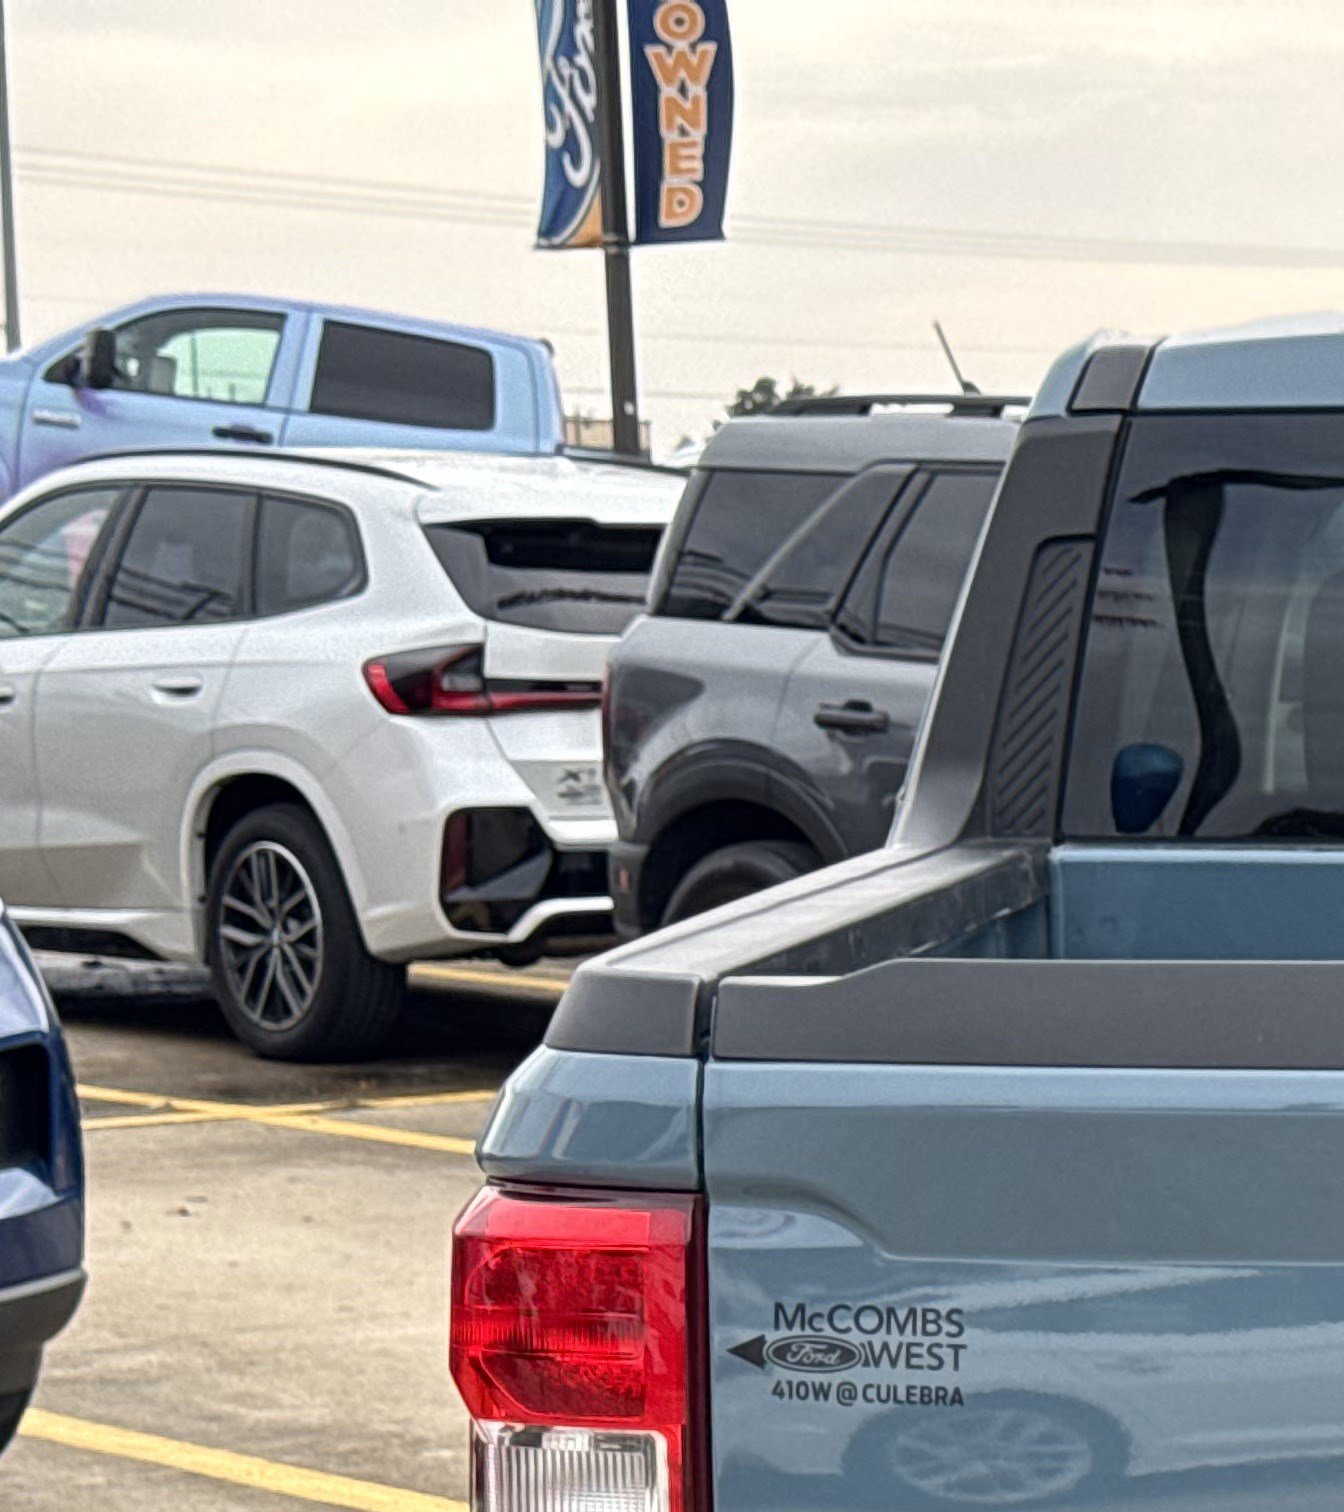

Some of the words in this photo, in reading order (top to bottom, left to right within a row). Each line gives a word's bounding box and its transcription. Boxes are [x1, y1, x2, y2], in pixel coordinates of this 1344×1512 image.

[773, 1301, 966, 1339] McCOMBS
[786, 1342, 842, 1364] Ford
[866, 1340, 968, 1372] WEST
